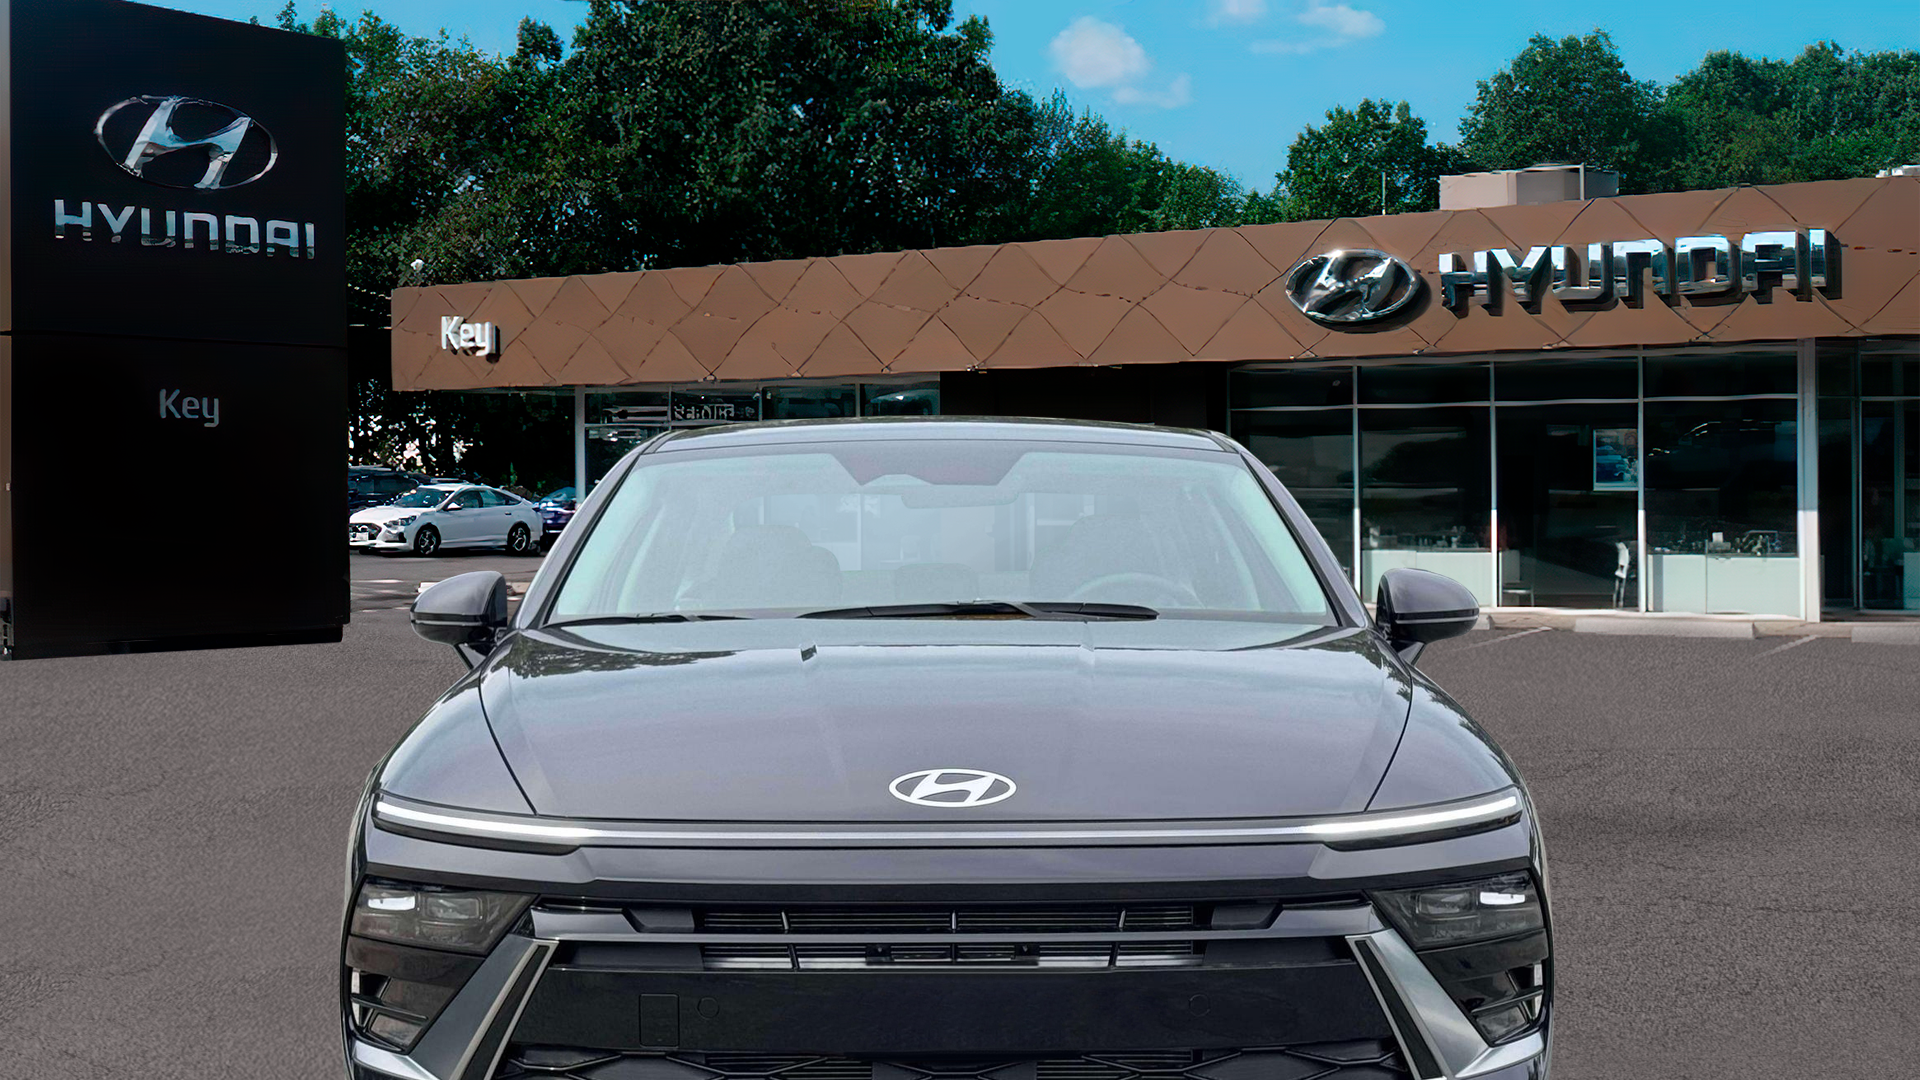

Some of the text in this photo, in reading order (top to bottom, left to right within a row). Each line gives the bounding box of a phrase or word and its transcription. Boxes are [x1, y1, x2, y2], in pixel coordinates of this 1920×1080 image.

[54, 199, 315, 260] HYUNDAI
[1438, 228, 1840, 314] HYUNDAI
[441, 315, 493, 357] Key
[159, 388, 220, 428] Key
